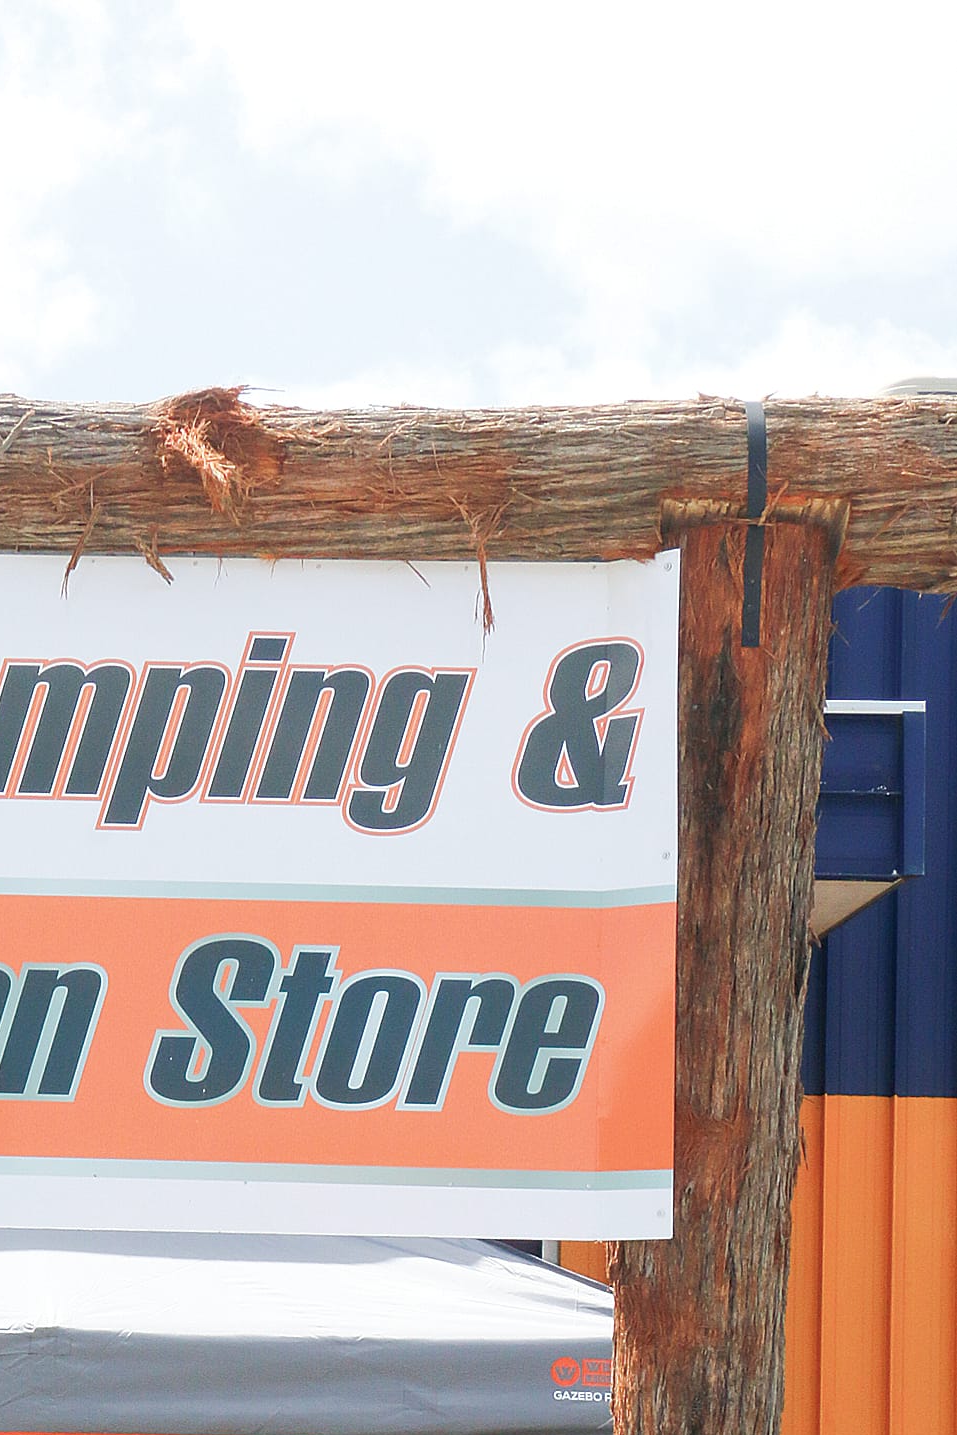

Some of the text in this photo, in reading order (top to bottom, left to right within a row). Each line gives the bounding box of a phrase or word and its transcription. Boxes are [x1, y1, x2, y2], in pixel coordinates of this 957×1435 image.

[511, 633, 646, 814] &
[142, 932, 607, 1116] Store
[553, 1390, 603, 1402] GAZEBO
